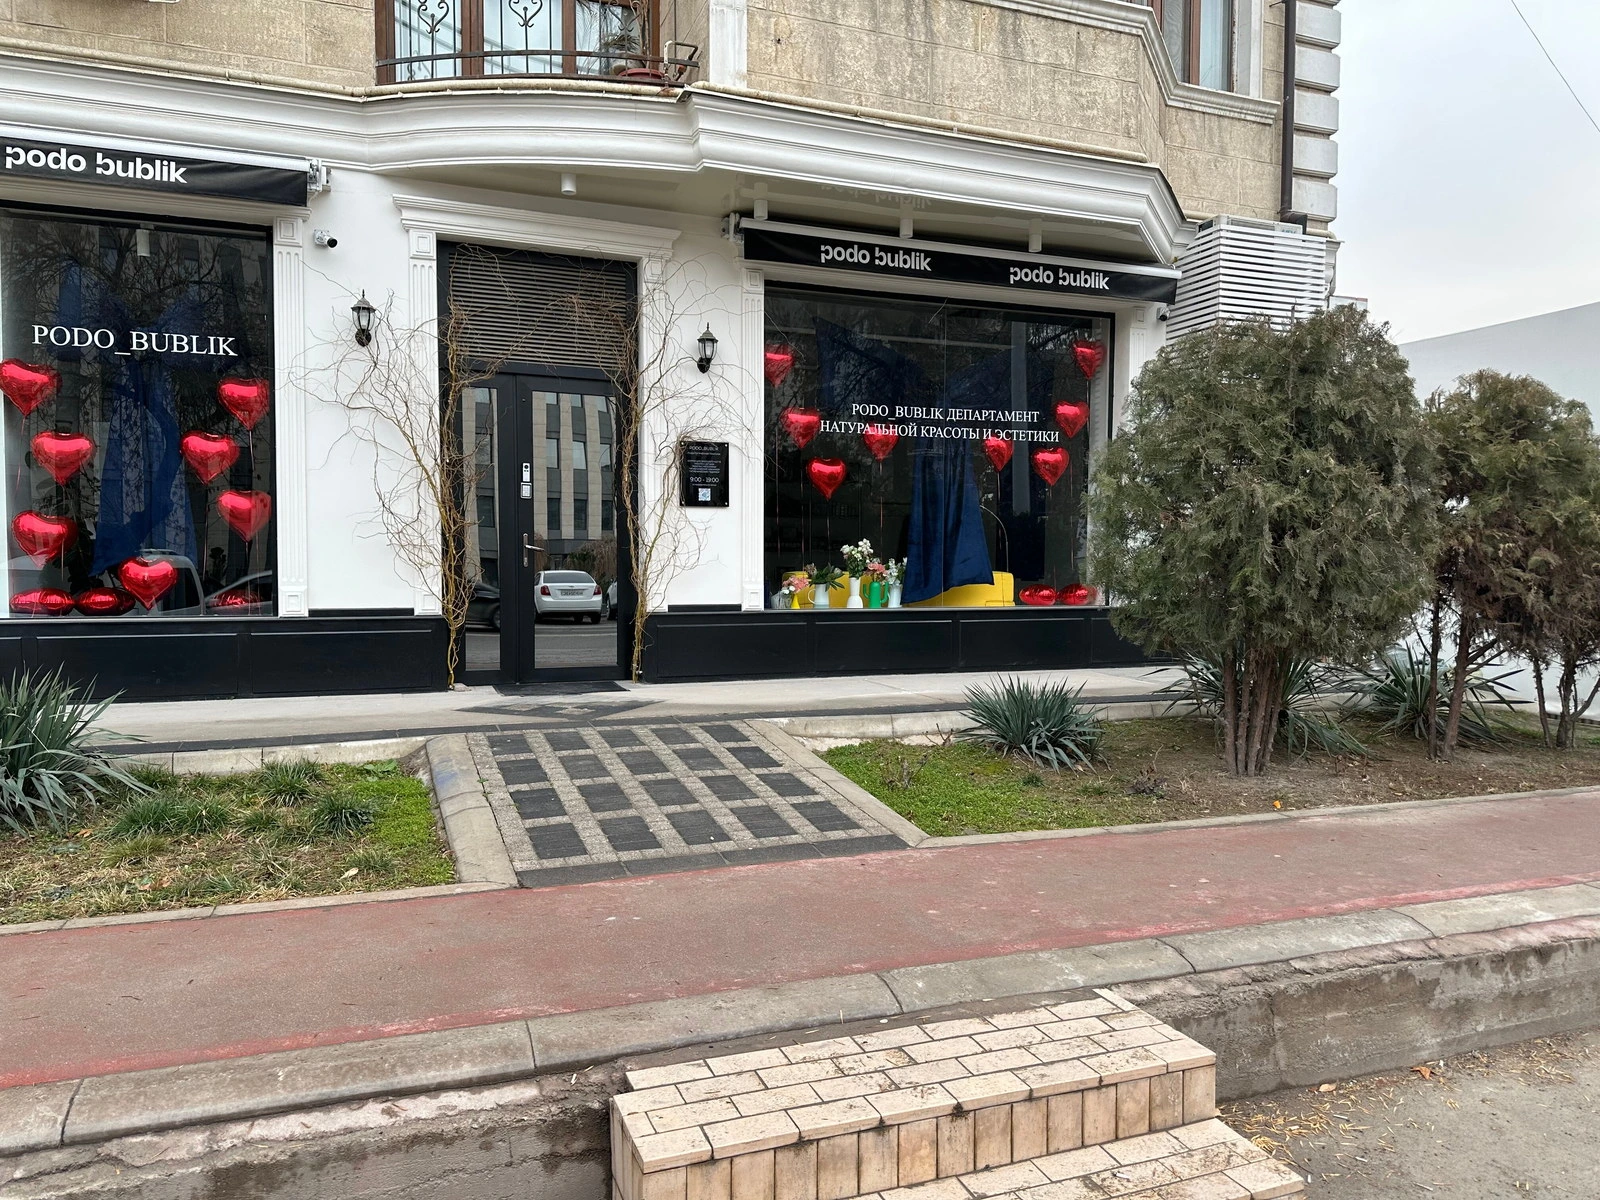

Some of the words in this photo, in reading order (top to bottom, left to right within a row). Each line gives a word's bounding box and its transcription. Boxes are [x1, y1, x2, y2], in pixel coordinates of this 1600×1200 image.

[5, 146, 87, 172] podo
[96, 152, 188, 184] bublik
[820, 244, 871, 264] podo
[874, 247, 932, 272] bublik
[1009, 266, 1054, 285] podo
[1058, 268, 1110, 291] bublik
[32, 325, 238, 356] PODO_BUBLIK
[852, 403, 943, 420] PODO_BUBLIK
[946, 409, 1040, 423] ДЕПАРТАМЕНТ
[820, 420, 917, 437] НАТУРАЛЬНОЙ
[920, 426, 980, 440] КРАСОТЫ
[982, 429, 993, 440] И
[994, 429, 1060, 443] ЭСТЕТИКИ
